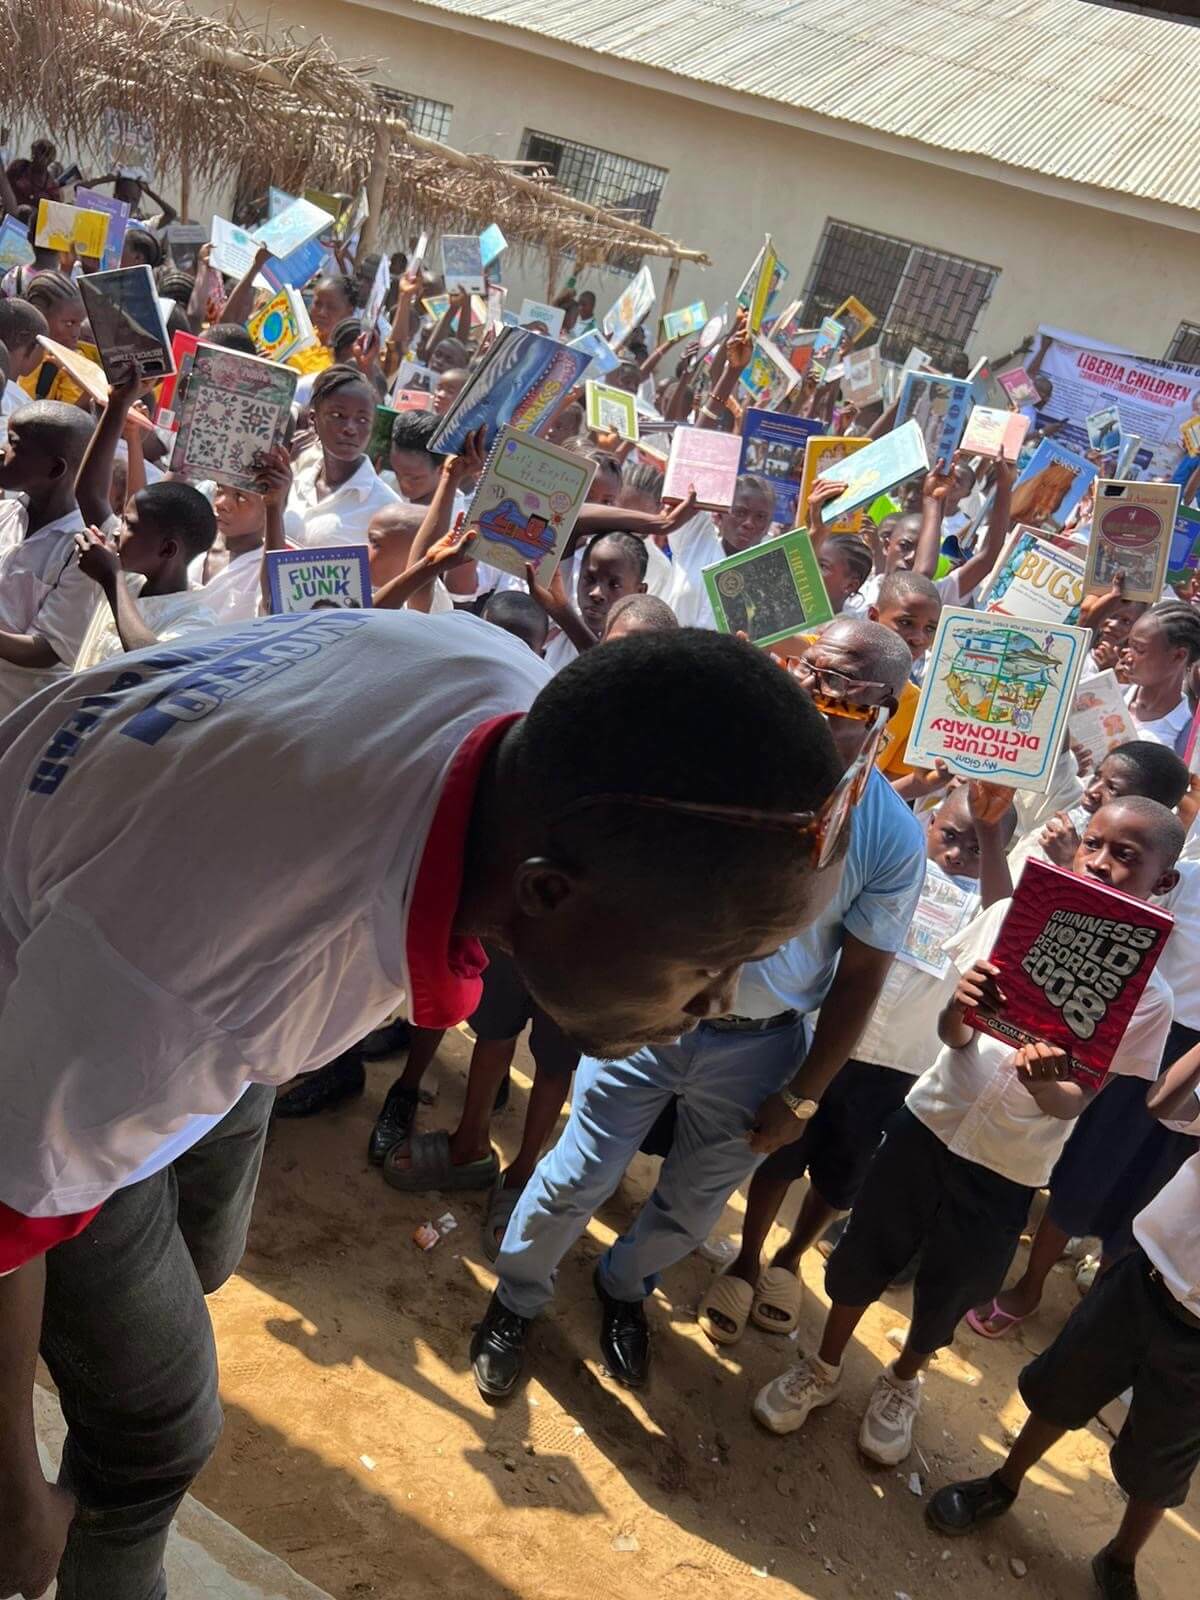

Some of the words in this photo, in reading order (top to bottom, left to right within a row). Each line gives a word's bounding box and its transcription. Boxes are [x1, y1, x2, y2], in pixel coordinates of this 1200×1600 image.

[1077, 352, 1126, 384] LIBERIA
[1126, 370, 1192, 403] CHILDREN
[288, 565, 351, 585] FUNKY
[292, 580, 350, 600] JUNK
[1013, 551, 1084, 607] BUGS
[156, 618, 367, 721] MOTTO
[930, 717, 1041, 750] DICTIONARY
[943, 734, 1018, 763] PICTURE
[955, 753, 981, 768] Giant
[982, 757, 998, 770] My
[1043, 921, 1141, 976] WORLD
[1051, 909, 1157, 951] GUINNESS
[1034, 934, 1123, 1000] RECORDS
[1021, 947, 1107, 1040] 2008
